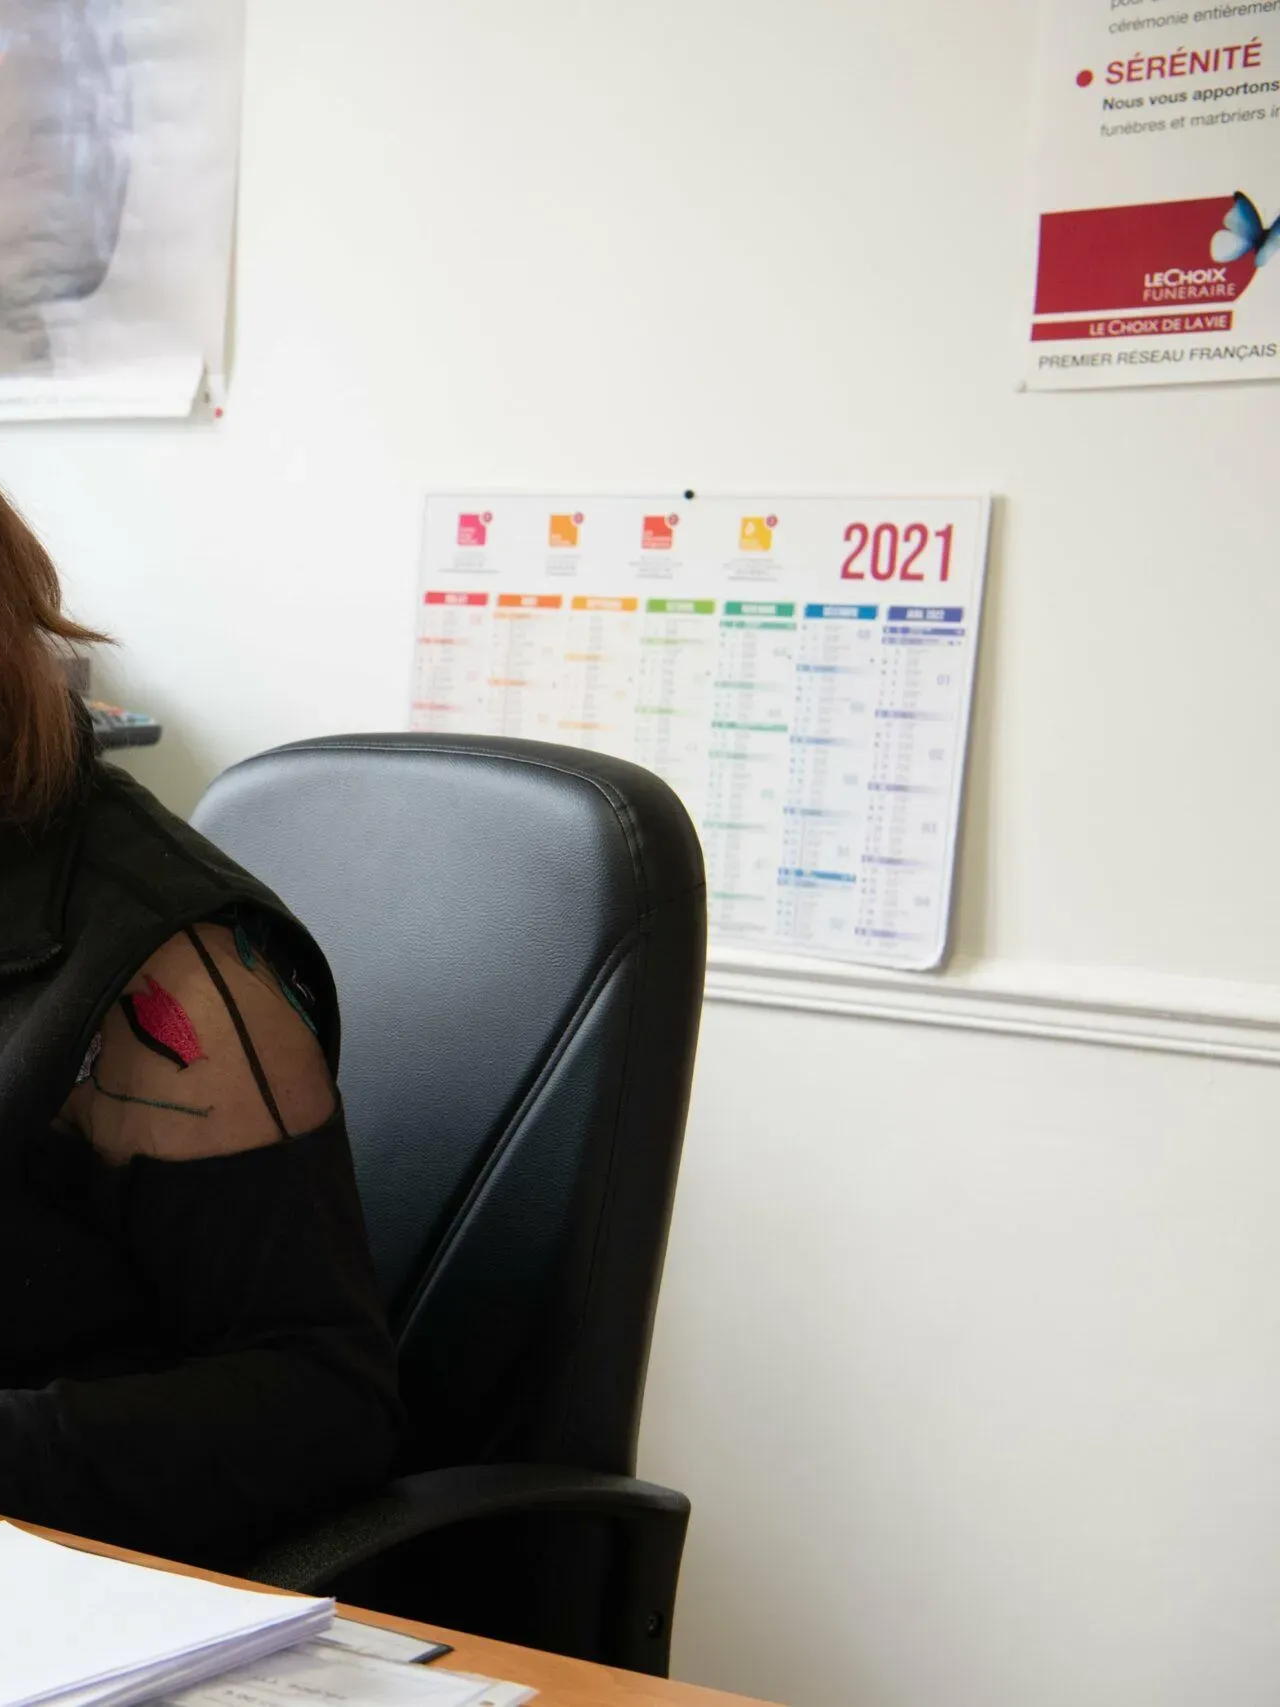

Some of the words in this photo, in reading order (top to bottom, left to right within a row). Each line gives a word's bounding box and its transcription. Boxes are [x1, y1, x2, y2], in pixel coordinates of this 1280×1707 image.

[1108, 12, 1189, 34] cérémonie
[1105, 36, 1263, 85] SÉRÉNITÉ
[1102, 96, 1144, 111] Nous
[1149, 90, 1188, 106] vous
[1192, 80, 1280, 104] apportons
[1100, 118, 1166, 137] funèbres
[1170, 115, 1186, 130] et
[1190, 107, 1266, 128] marbriers
[1089, 322, 1106, 336] LE
[1107, 319, 1160, 335] CHOIX
[1162, 318, 1182, 331] DE
[1184, 317, 1204, 331] LA
[1205, 314, 1228, 329] VIE
[1038, 352, 1112, 370] PREMIER
[1117, 346, 1184, 365] RÉSEAU
[1189, 342, 1278, 364] FRANÇAIS
[839, 521, 955, 583] 2021
